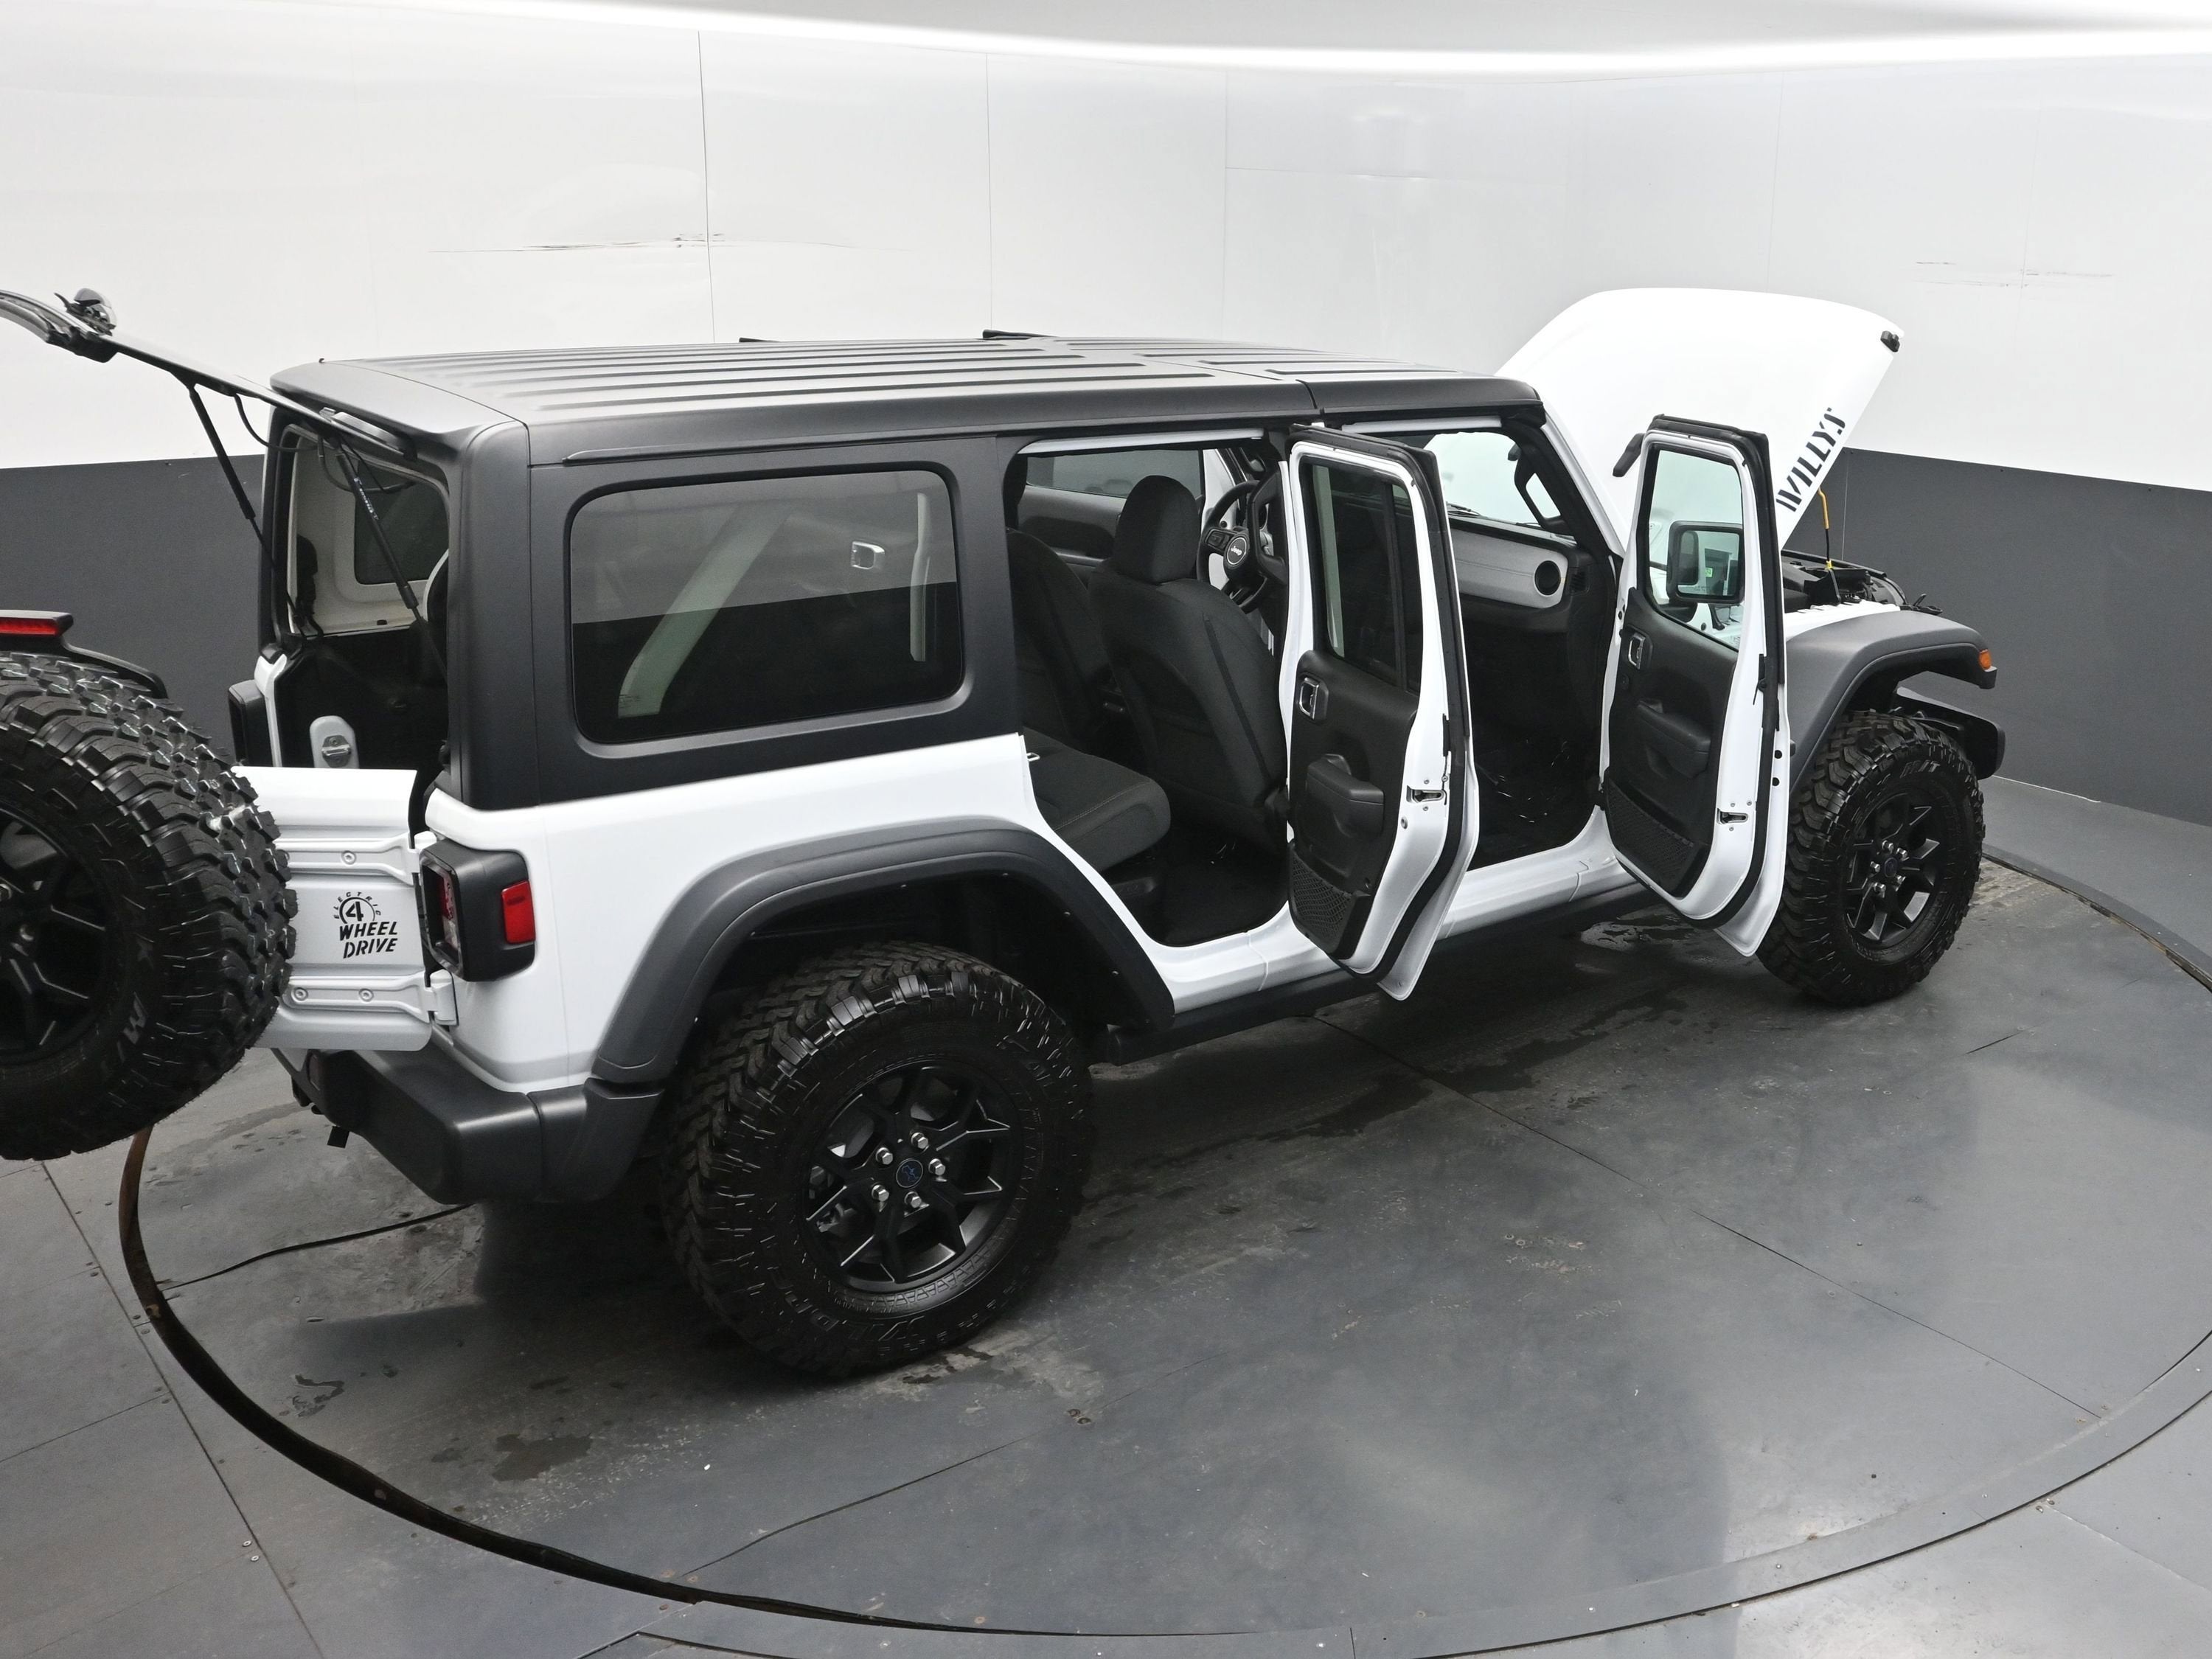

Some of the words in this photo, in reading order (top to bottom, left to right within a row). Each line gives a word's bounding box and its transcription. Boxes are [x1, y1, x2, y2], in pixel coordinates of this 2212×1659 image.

[1231, 545, 1242, 556] Jeep
[333, 891, 381, 919] ELECTRIC
[345, 901, 364, 922] 4
[339, 922, 398, 941] WHEEL
[343, 938, 398, 959] DRIVE
